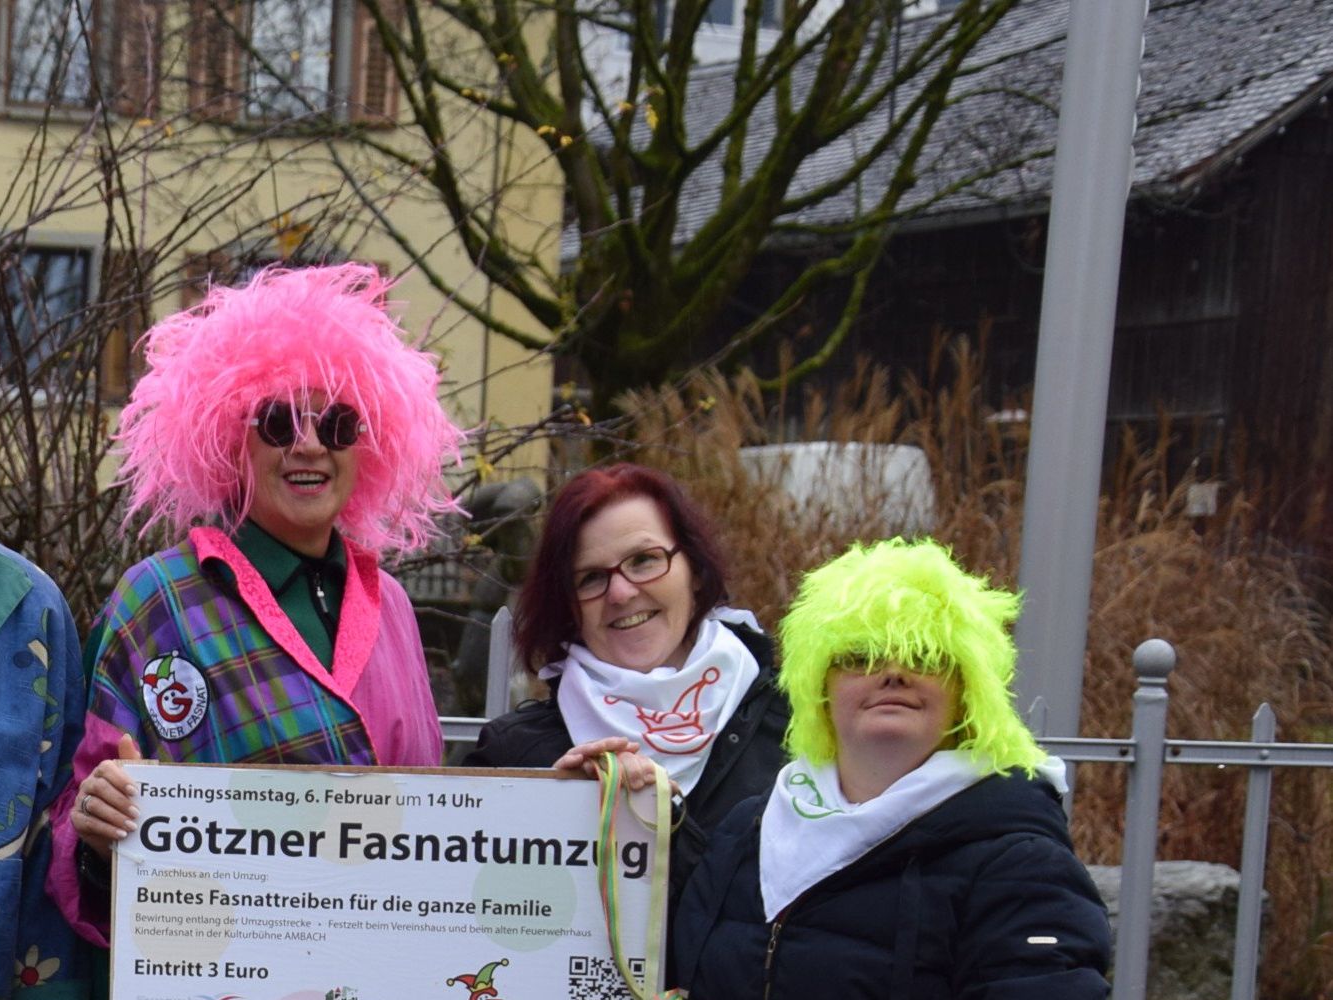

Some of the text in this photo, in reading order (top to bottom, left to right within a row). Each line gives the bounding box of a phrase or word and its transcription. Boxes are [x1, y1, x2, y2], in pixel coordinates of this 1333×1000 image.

[187, 686, 206, 729] FASNAT
[140, 783, 483, 808] Faschingssamstag, 6. Februar um 14 Uhr
[140, 815, 326, 858] Götzner
[137, 867, 269, 883] Im Anschluss an den Umzug:
[137, 887, 552, 917] Buntes Fasnattreiben für die ganze Familie
[135, 913, 593, 937] Bewirtung entlang der Umzugsstrecke Festzelt beim Vereinshaus und beim alten Feuerwehrhaus
[135, 925, 327, 942] Kinderfasnat in der Kulturbühne AMBACH
[134, 959, 269, 980] Eintritt 3 Euro
